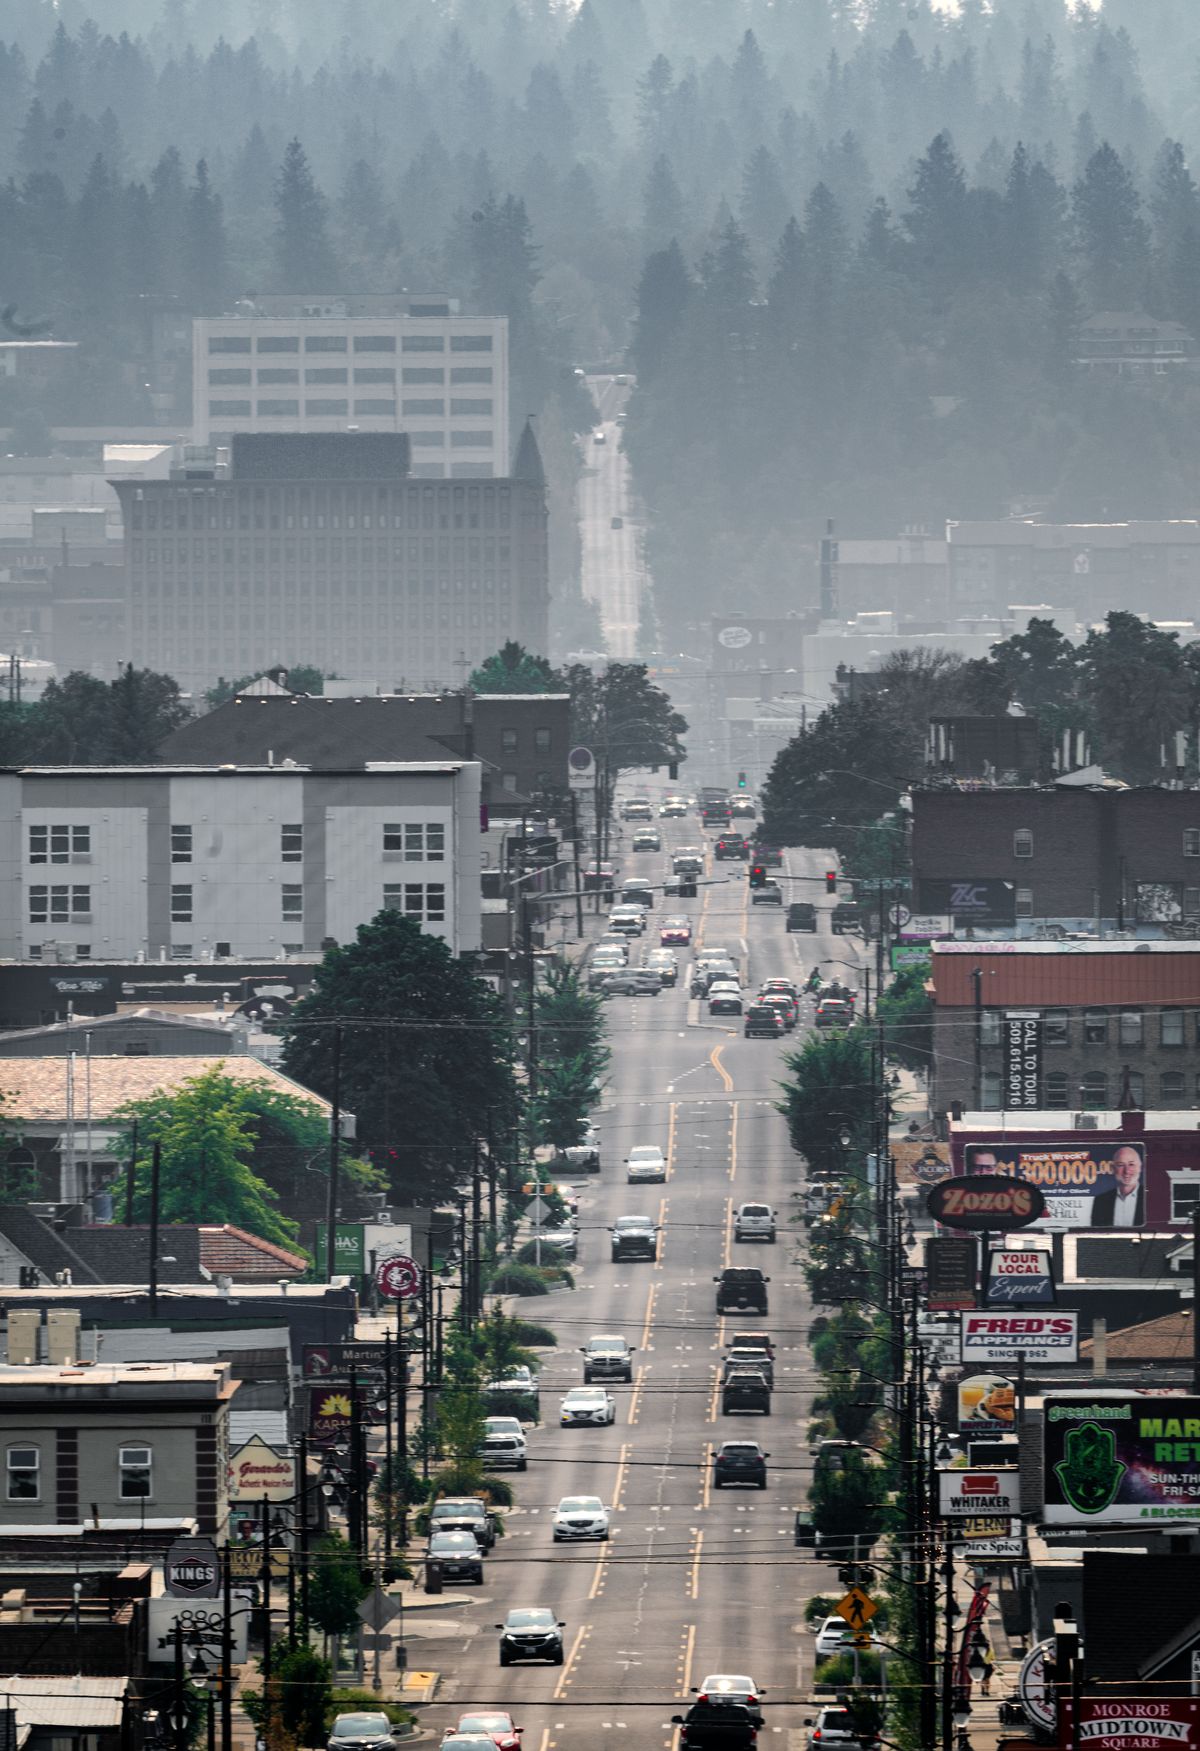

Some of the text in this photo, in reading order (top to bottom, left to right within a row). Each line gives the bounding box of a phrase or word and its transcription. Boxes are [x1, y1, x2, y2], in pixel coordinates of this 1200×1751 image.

[1009, 1021, 1022, 1105] 509.615.9016
[1024, 1021, 1038, 1105] CALL TO TOUR
[1000, 1254, 1039, 1264] YOUR
[998, 1264, 1041, 1274] LOCAL
[988, 1277, 1049, 1300] Expert
[967, 1318, 1074, 1334] FRED'S
[968, 1336, 1072, 1346] APPLIANCE
[342, 1350, 387, 1359] Martin'
[987, 1349, 1019, 1358] SINCE
[1150, 1473, 1200, 1484] SUN-TH
[950, 1496, 1011, 1508] WHITAKER
[990, 1541, 1021, 1552] Spice
[170, 1567, 215, 1581] KINGS
[1092, 1704, 1170, 1717] MONROE
[1079, 1720, 1184, 1738] MIDTOWN
[1101, 1738, 1160, 1750] SQUARE
